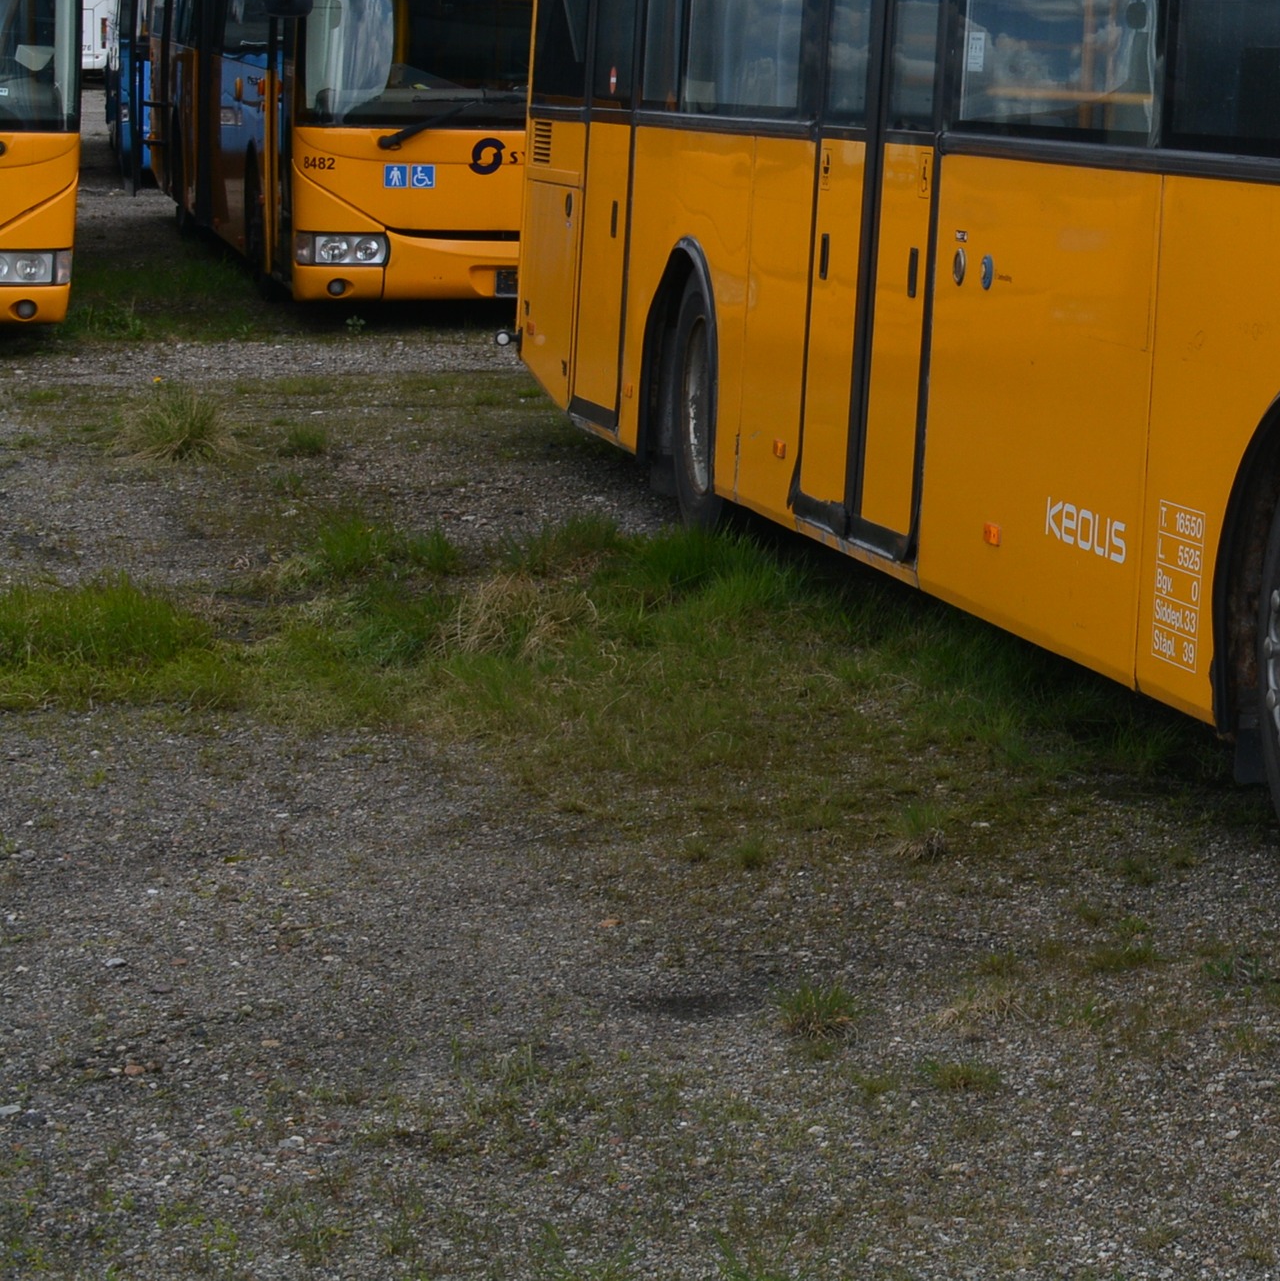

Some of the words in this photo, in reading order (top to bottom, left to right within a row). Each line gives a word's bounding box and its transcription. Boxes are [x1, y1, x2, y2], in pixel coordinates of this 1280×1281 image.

[303, 156, 335, 170] 8482
[1045, 496, 1126, 564] KEOLIS
[1175, 512, 1203, 539] 16550
[1177, 545, 1201, 571] 5525
[1156, 569, 1173, 595] Bgv.
[1191, 581, 1198, 602] 0
[1154, 599, 1184, 630] Siddepl.
[1184, 612, 1196, 634] 33
[1153, 629, 1176, 658] Ståpl.
[1182, 641, 1195, 665] 39
